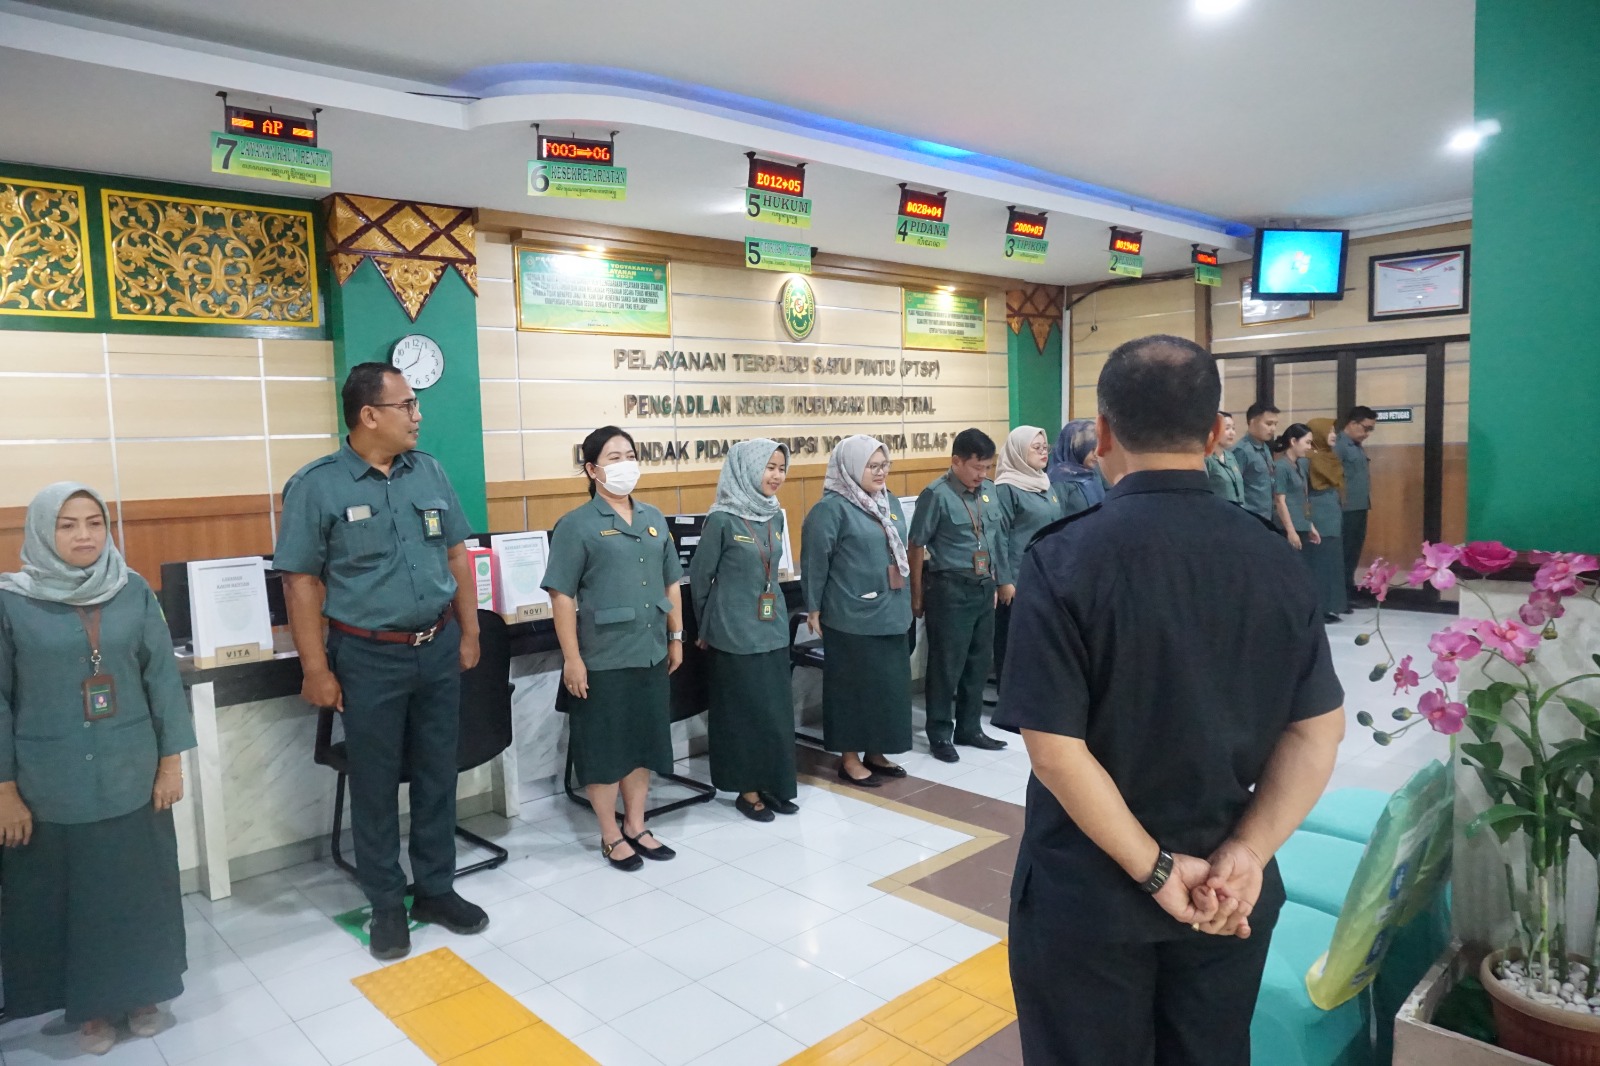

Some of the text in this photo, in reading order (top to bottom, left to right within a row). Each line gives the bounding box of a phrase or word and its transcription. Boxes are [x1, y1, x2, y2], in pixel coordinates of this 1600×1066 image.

[262, 119, 283, 135] AP
[216, 137, 238, 169] 7
[531, 165, 549, 193] 6
[551, 165, 625, 184] KESEKRETARIATAN
[748, 193, 760, 217] 5
[763, 194, 808, 213] HUKUM
[898, 220, 908, 241] 4
[910, 220, 946, 237] PIDANA
[748, 241, 760, 265] 5
[1005, 238, 1015, 257] 3
[1016, 239, 1048, 252] TIPIKOR
[1110, 254, 1118, 271] 2
[412, 339, 420, 347] 12
[434, 358, 438, 366] 3
[613, 348, 941, 380] PELAYANAN TERPADU SATU PINTU (PTSP)
[416, 378, 420, 386] 6
[424, 374, 430, 382] 5
[623, 394, 732, 418] PENGADILAN
[867, 396, 937, 416] INDUSTRIAL
[634, 440, 690, 462] INDAK
[911, 431, 948, 451] KELAS
[523, 607, 542, 616] NOVI
[226, 650, 250, 658] VITA
